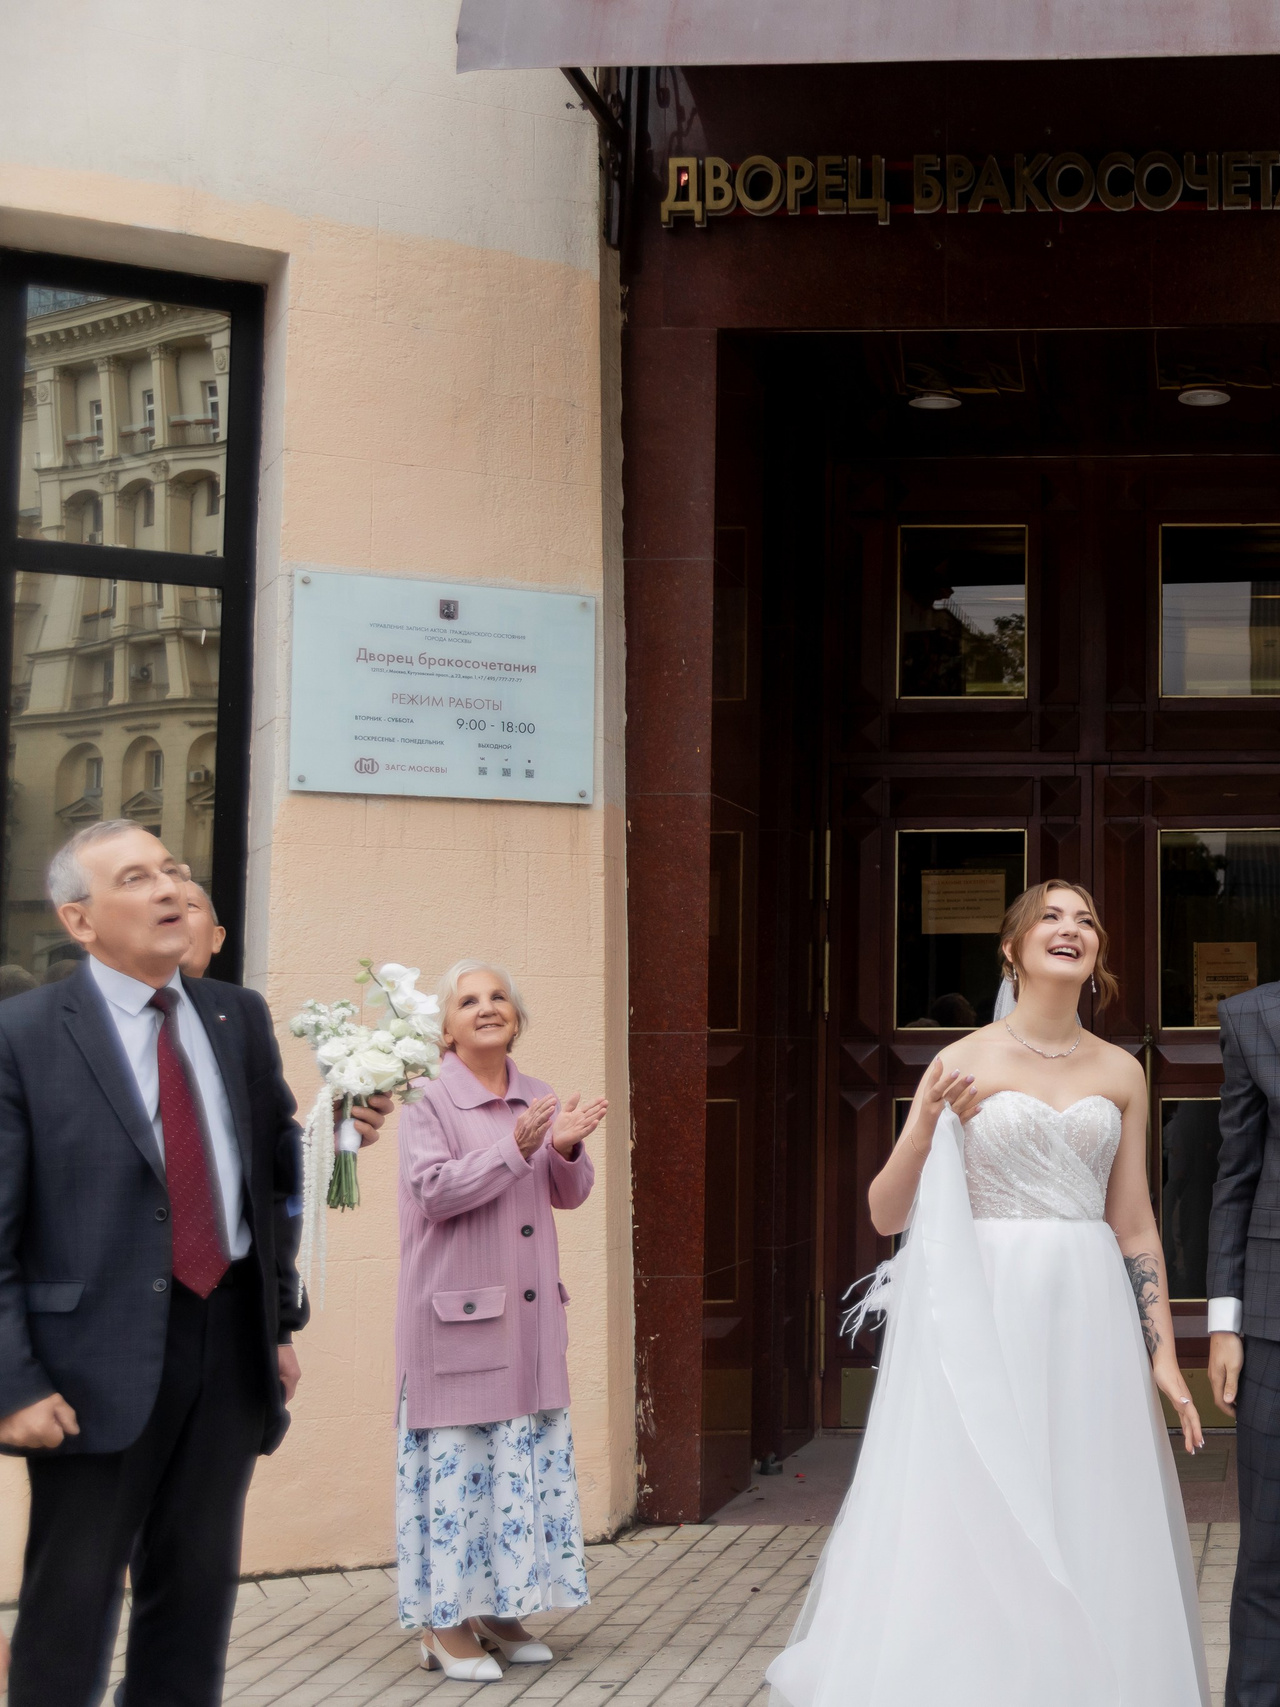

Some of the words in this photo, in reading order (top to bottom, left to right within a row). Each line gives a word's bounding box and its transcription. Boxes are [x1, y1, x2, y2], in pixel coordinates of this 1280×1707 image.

[660, 154, 890, 229] ДВОРЕЦ
[369, 622, 405, 631] УПРАВЛЕНИЕ
[450, 629, 492, 638] ГРАЖДАНСКОГО
[492, 632, 526, 640] СОСТОЯНИЯ
[424, 635, 447, 643] ГОРОДА
[356, 648, 414, 666] Дворец
[418, 652, 537, 674] бракосочетания
[392, 692, 444, 708] РЕЖИМ
[449, 696, 502, 711] РАБОТЫ
[456, 718, 486, 731] 9:00
[501, 721, 536, 734] 18:00
[354, 735, 396, 743] ВОСКРЕСЕНЬЕ
[401, 738, 445, 746] ПОНЕДЕЛЬНИК
[384, 764, 408, 772] ЗАГС
[408, 764, 448, 774] МОСКВЫ
